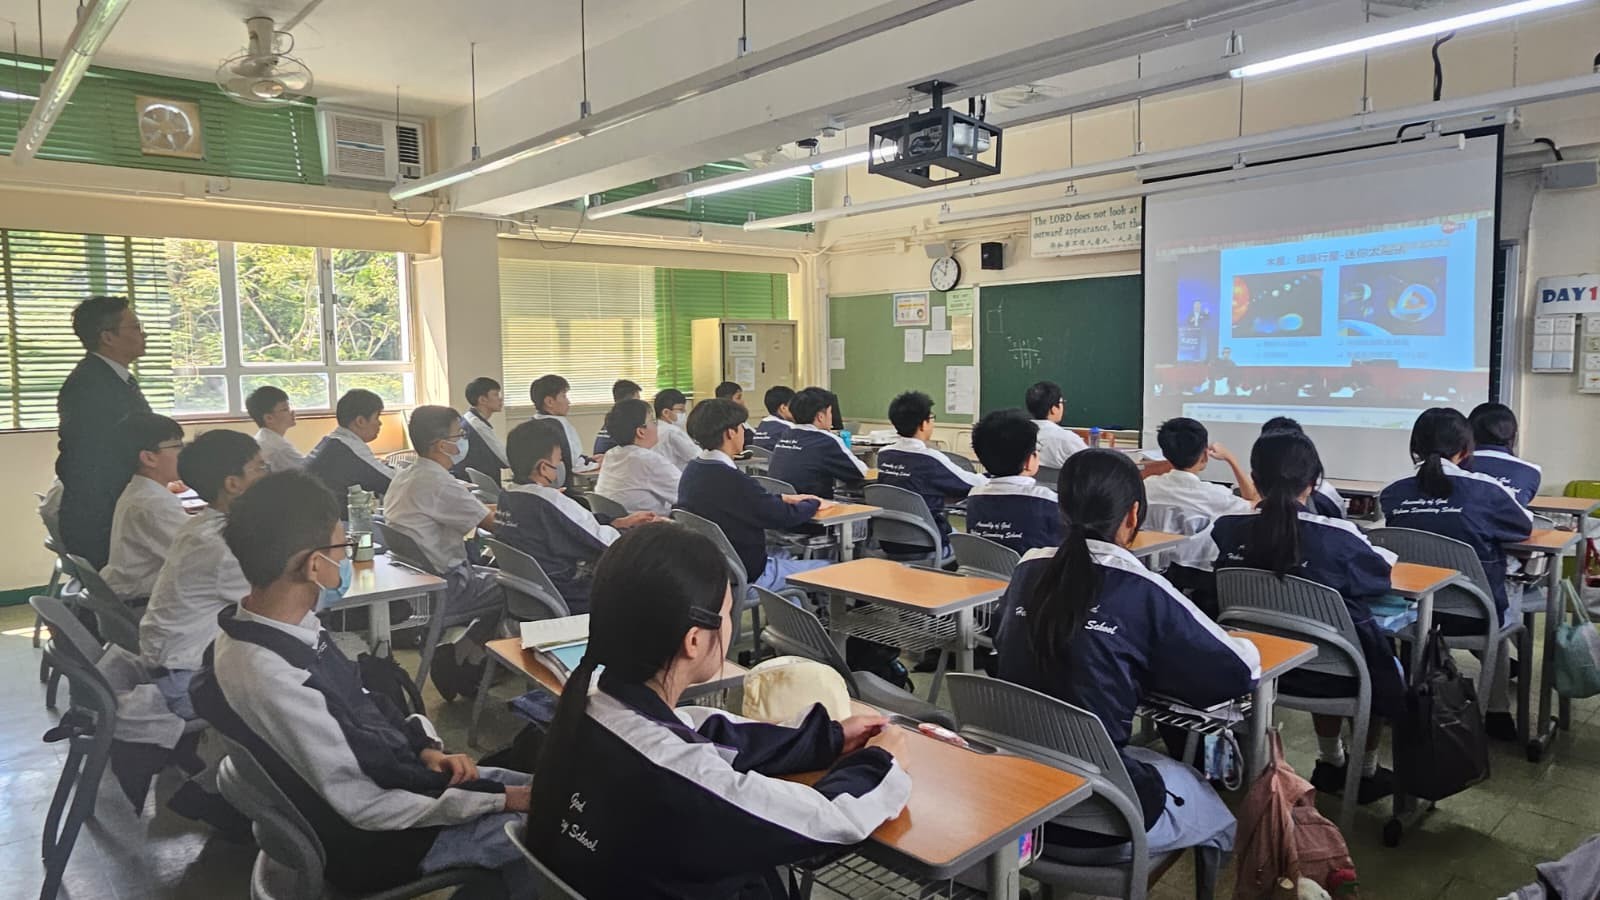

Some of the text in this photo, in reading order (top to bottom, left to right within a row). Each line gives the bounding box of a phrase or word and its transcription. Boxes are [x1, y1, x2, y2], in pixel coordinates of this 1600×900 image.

[1033, 204, 1138, 225] The LORD does not look at
[1033, 227, 1063, 239] outward
[1112, 219, 1127, 230] but
[1542, 287, 1586, 304] DAY
[1085, 620, 1118, 635] School
[569, 792, 587, 813] God
[568, 823, 599, 852] School
